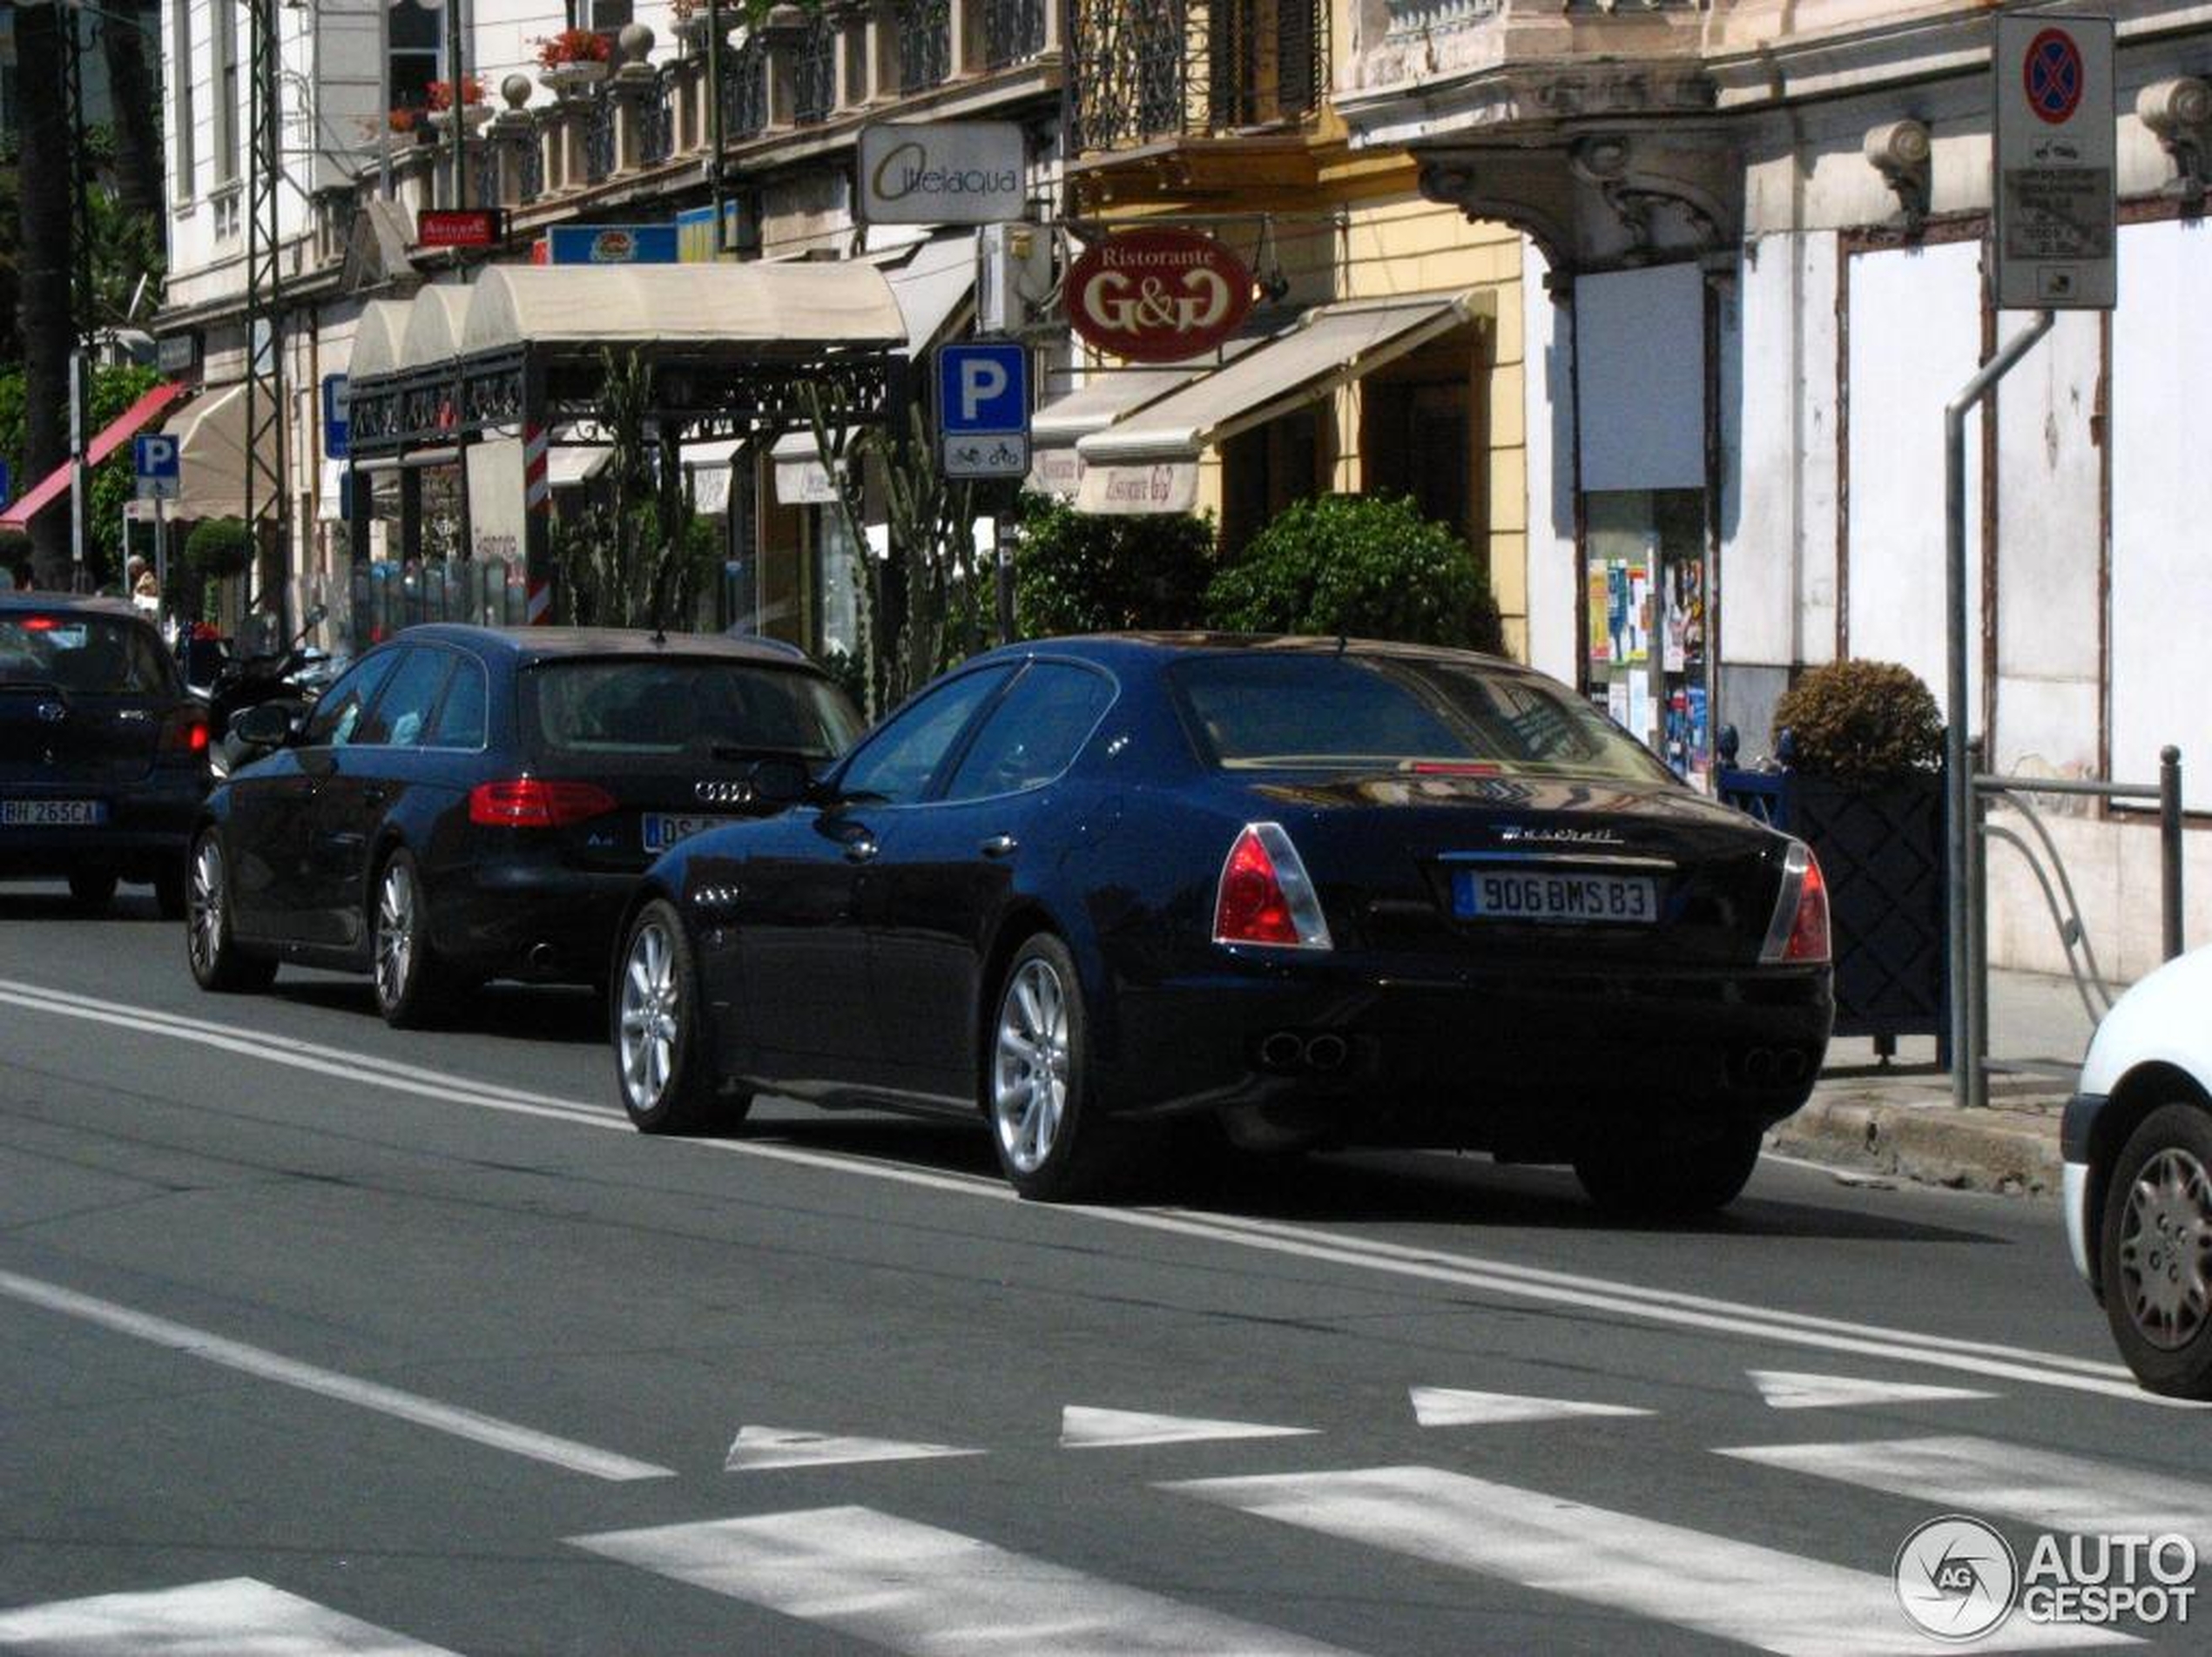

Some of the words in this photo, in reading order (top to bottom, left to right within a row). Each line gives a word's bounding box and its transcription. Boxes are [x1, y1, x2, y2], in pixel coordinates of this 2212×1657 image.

[1102, 247, 1217, 267] Ristorante
[961, 360, 1008, 421] P
[145, 439, 172, 474] P
[1484, 878, 1542, 912] 906
[1547, 879, 1603, 914] BMS
